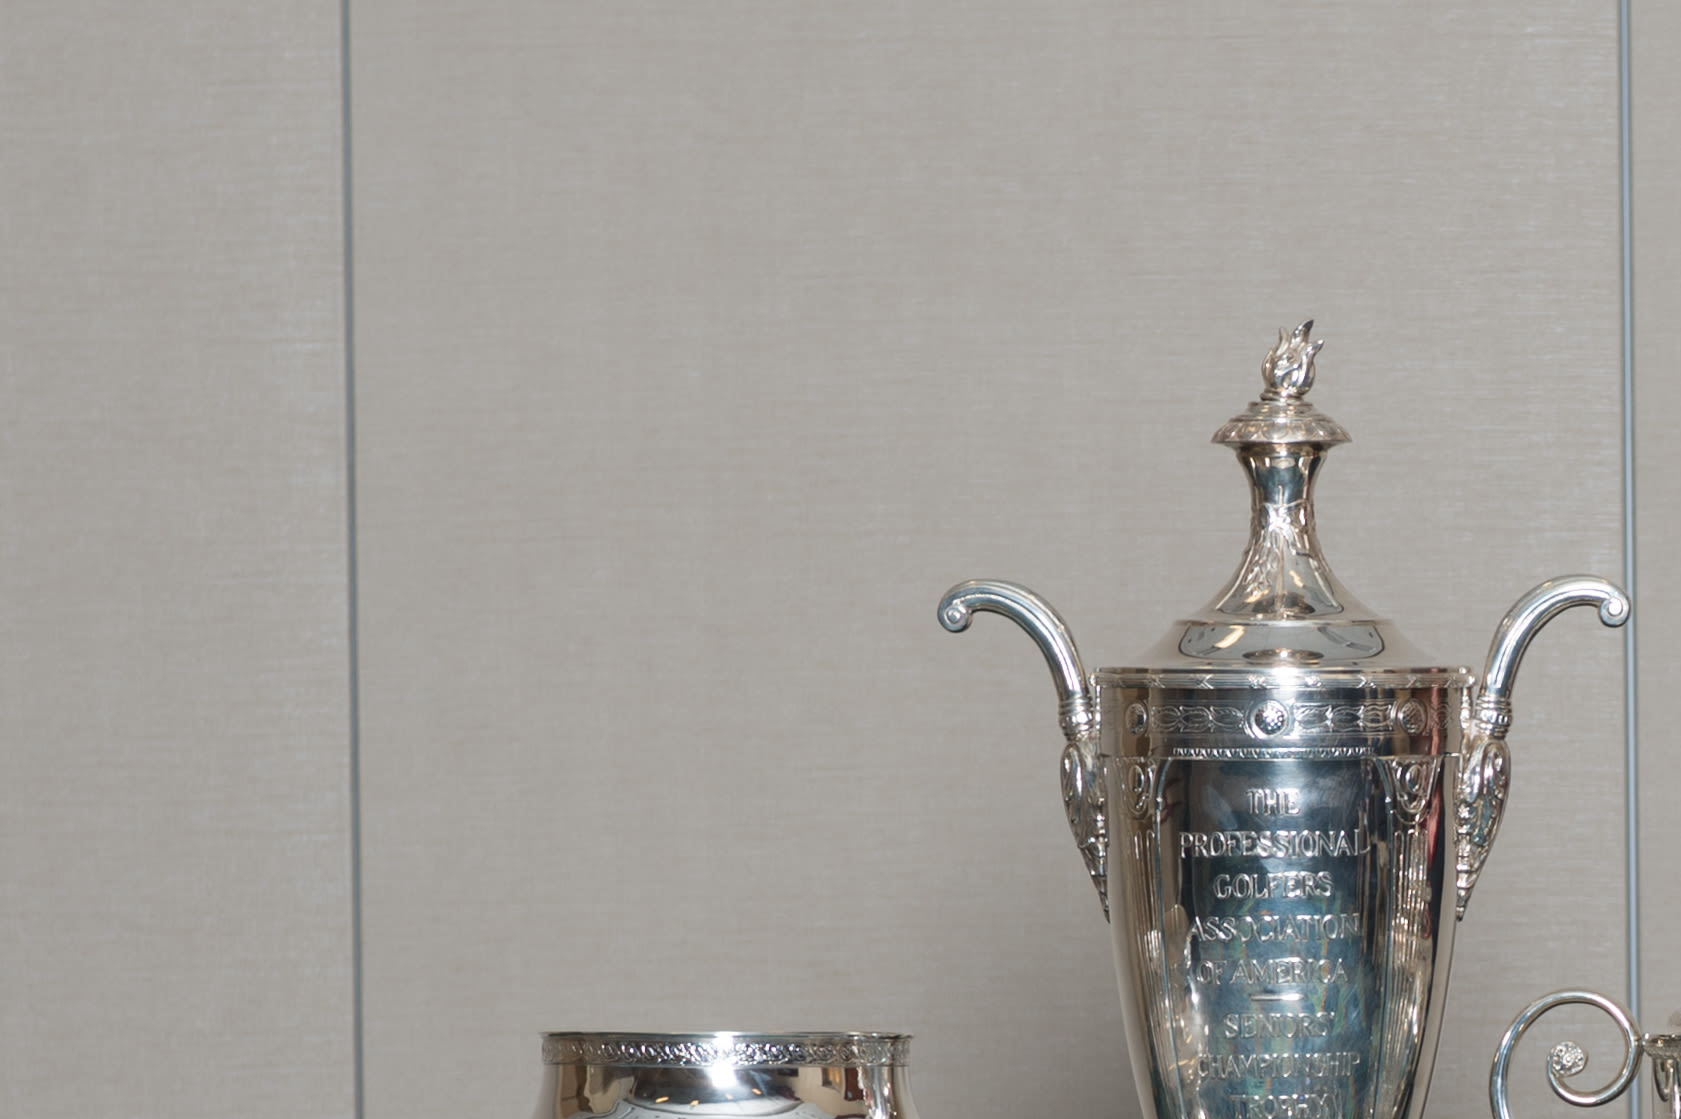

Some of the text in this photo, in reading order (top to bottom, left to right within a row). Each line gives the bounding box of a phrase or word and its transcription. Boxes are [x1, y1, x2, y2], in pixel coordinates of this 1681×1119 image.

[1247, 788, 1300, 816] THE
[1179, 829, 1371, 858] PROFESSIONAL
[1213, 871, 1334, 899] GOLFERS
[1190, 912, 1361, 943] ASSOCIATION
[1196, 957, 1349, 985] OF AMERICA
[1197, 1052, 1361, 1079] CHAMPIONSHIP
